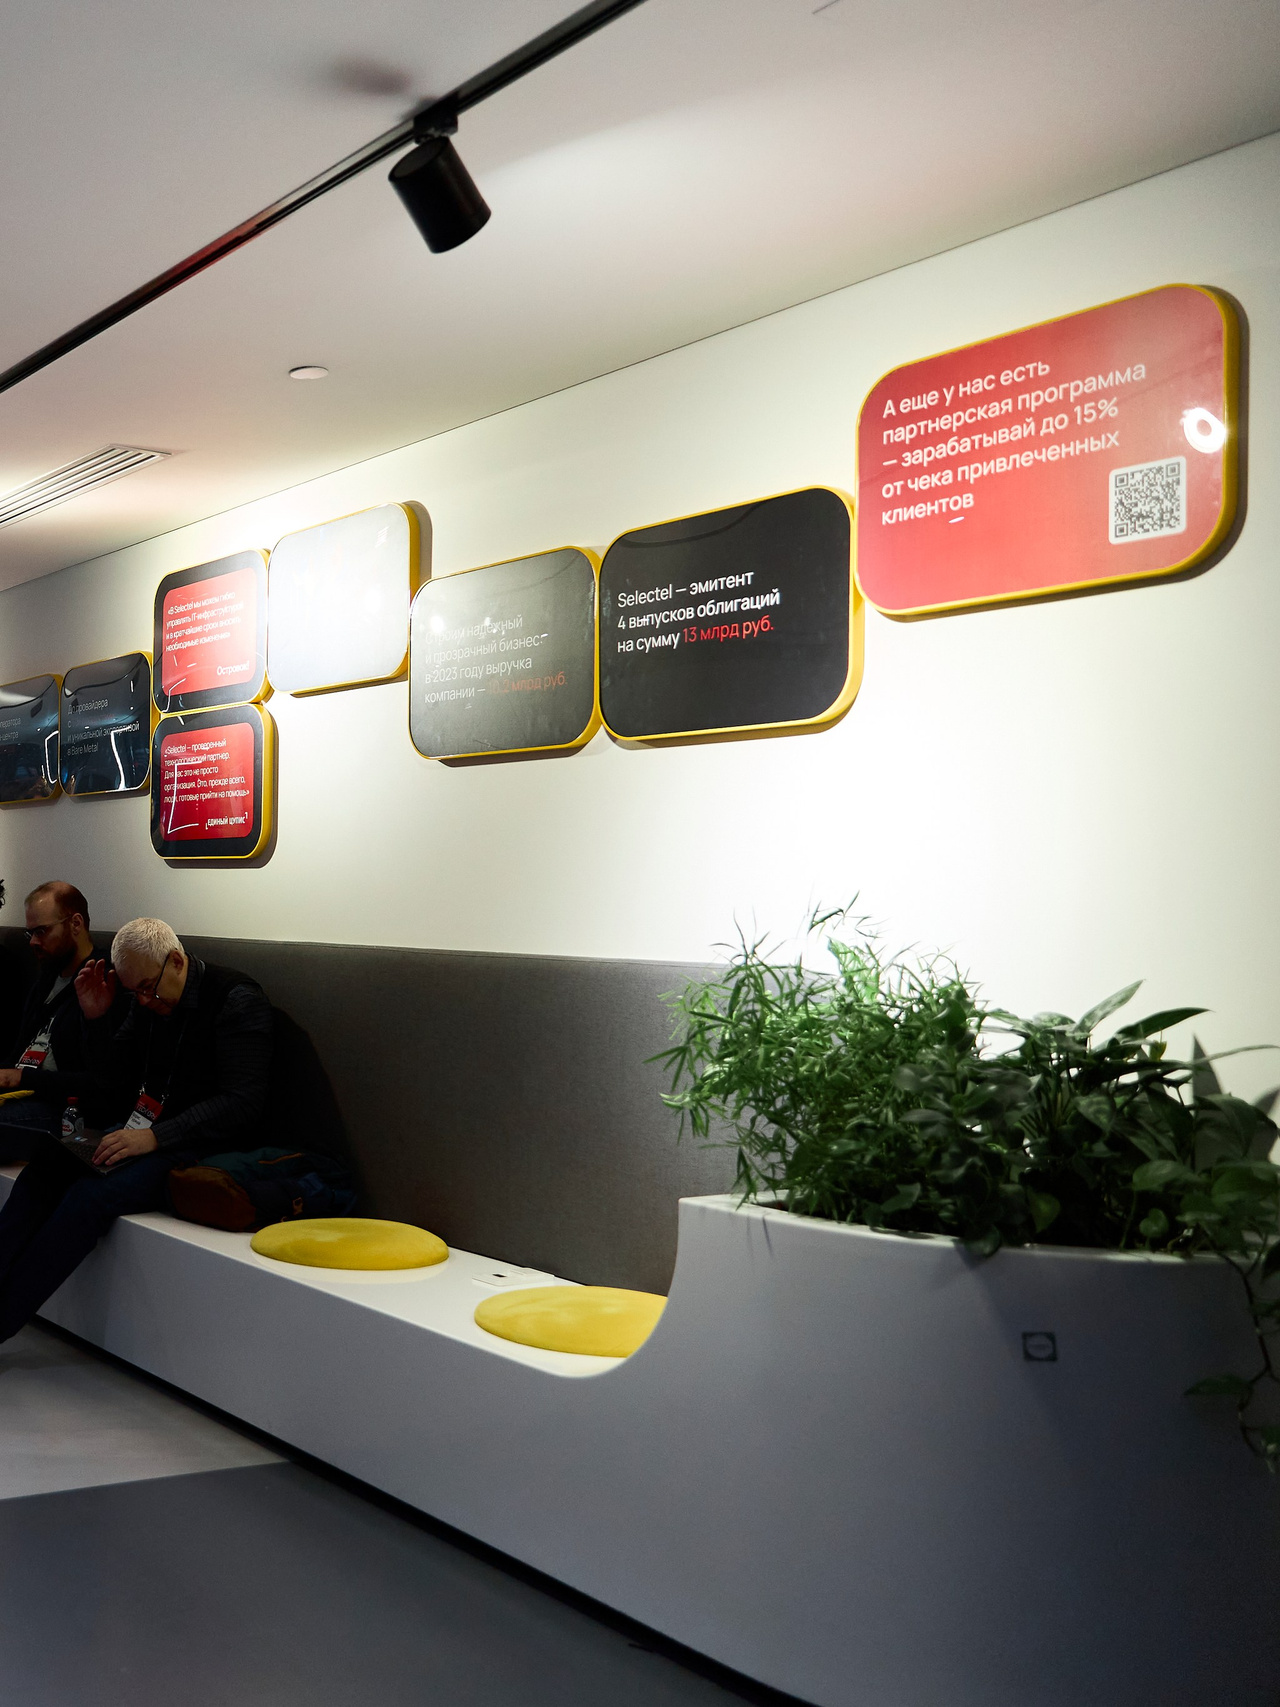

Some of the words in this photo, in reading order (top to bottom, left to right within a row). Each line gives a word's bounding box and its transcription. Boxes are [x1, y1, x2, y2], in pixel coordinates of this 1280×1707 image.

[883, 400, 896, 418] А
[900, 391, 939, 414] еще
[943, 386, 955, 406] у
[959, 374, 996, 398] нас
[1000, 361, 1050, 386] есть
[883, 399, 1012, 444] партнерская
[1017, 363, 1146, 412] программа
[901, 418, 1035, 467] зарабатывай
[1040, 413, 1069, 436] до
[1073, 397, 1119, 425] 15%
[882, 481, 903, 499] от
[908, 469, 952, 491] чека
[957, 431, 1120, 484] привлеченных
[882, 493, 974, 526] клиентов
[618, 584, 672, 608] Selectel
[689, 571, 754, 595] эмитент
[174, 601, 193, 614] Selectel
[202, 596, 219, 606] можем
[617, 616, 626, 629] 4
[628, 606, 694, 629] выпусков
[697, 588, 781, 618] облигаций
[166, 616, 191, 630] управлять
[174, 626, 202, 640] кратчайшие
[203, 622, 219, 632] сроки
[425, 627, 465, 645] Строим
[617, 639, 633, 653] на
[636, 632, 680, 653] сумму
[683, 627, 697, 643] 13
[700, 624, 739, 642] млрд
[742, 615, 774, 639] руб.
[166, 639, 199, 652] необходимые
[425, 654, 432, 665] и
[434, 640, 497, 663] прозрачный
[425, 674, 432, 684] в
[433, 667, 457, 683] 2023
[460, 666, 484, 679] году
[486, 657, 532, 676] выручка
[424, 687, 475, 704] компании
[511, 678, 541, 691] млрд
[544, 671, 568, 688] руб.
[75, 699, 108, 714] провайдера
[72, 728, 103, 743] уникальной
[72, 746, 83, 756] Bare
[84, 742, 99, 753] Metal
[191, 739, 226, 752] проверенный
[207, 753, 230, 762] партнер.
[164, 770, 174, 779] Для
[200, 766, 218, 776] просто
[209, 778, 228, 788] прежде
[179, 793, 199, 801] готовые
[200, 791, 218, 802] прийти
